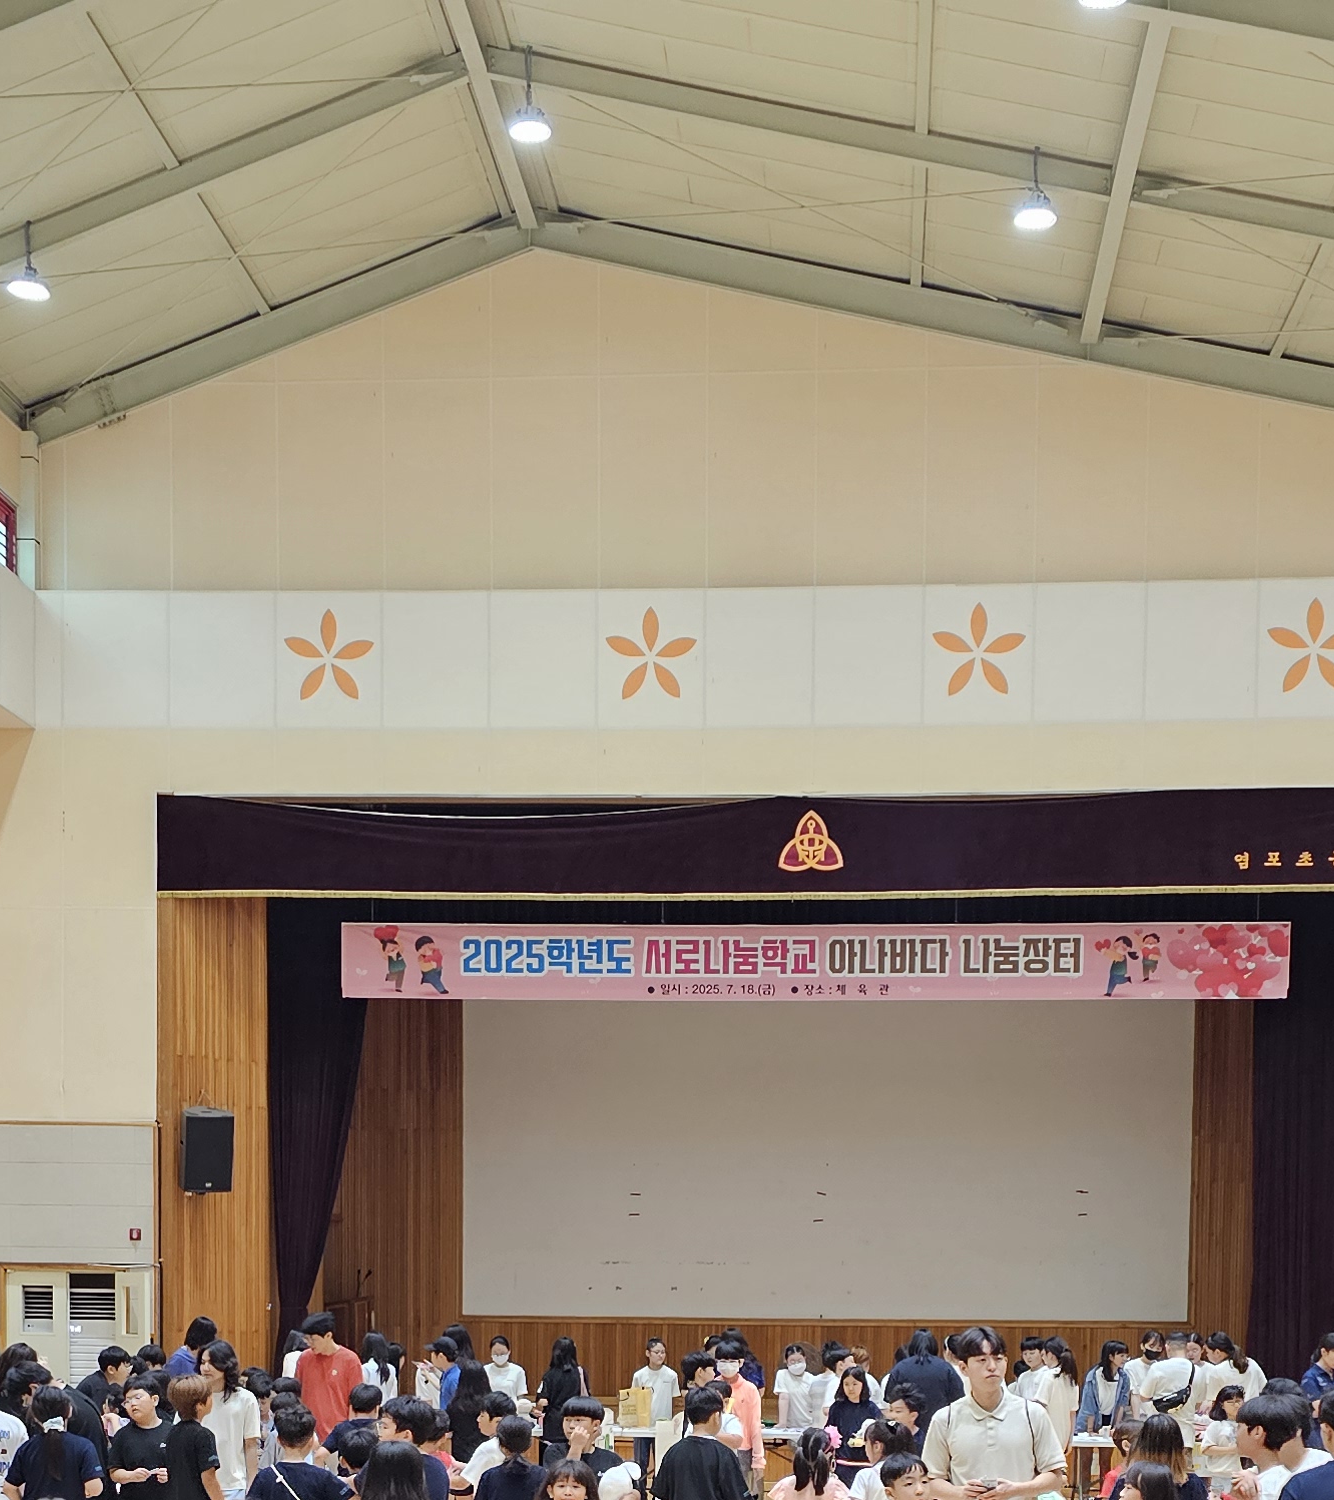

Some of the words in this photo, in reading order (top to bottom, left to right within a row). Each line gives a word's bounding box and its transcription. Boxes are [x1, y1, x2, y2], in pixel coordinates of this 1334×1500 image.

[462, 937, 633, 975] 2025학년도
[643, 938, 818, 976] 서로나눔학교
[828, 936, 949, 974] 아나바다
[961, 935, 1083, 974] 나눔장터
[660, 983, 681, 995] 일시
[691, 984, 723, 995] 2025.
[726, 984, 736, 995] 7.
[803, 984, 825, 995] 장소
